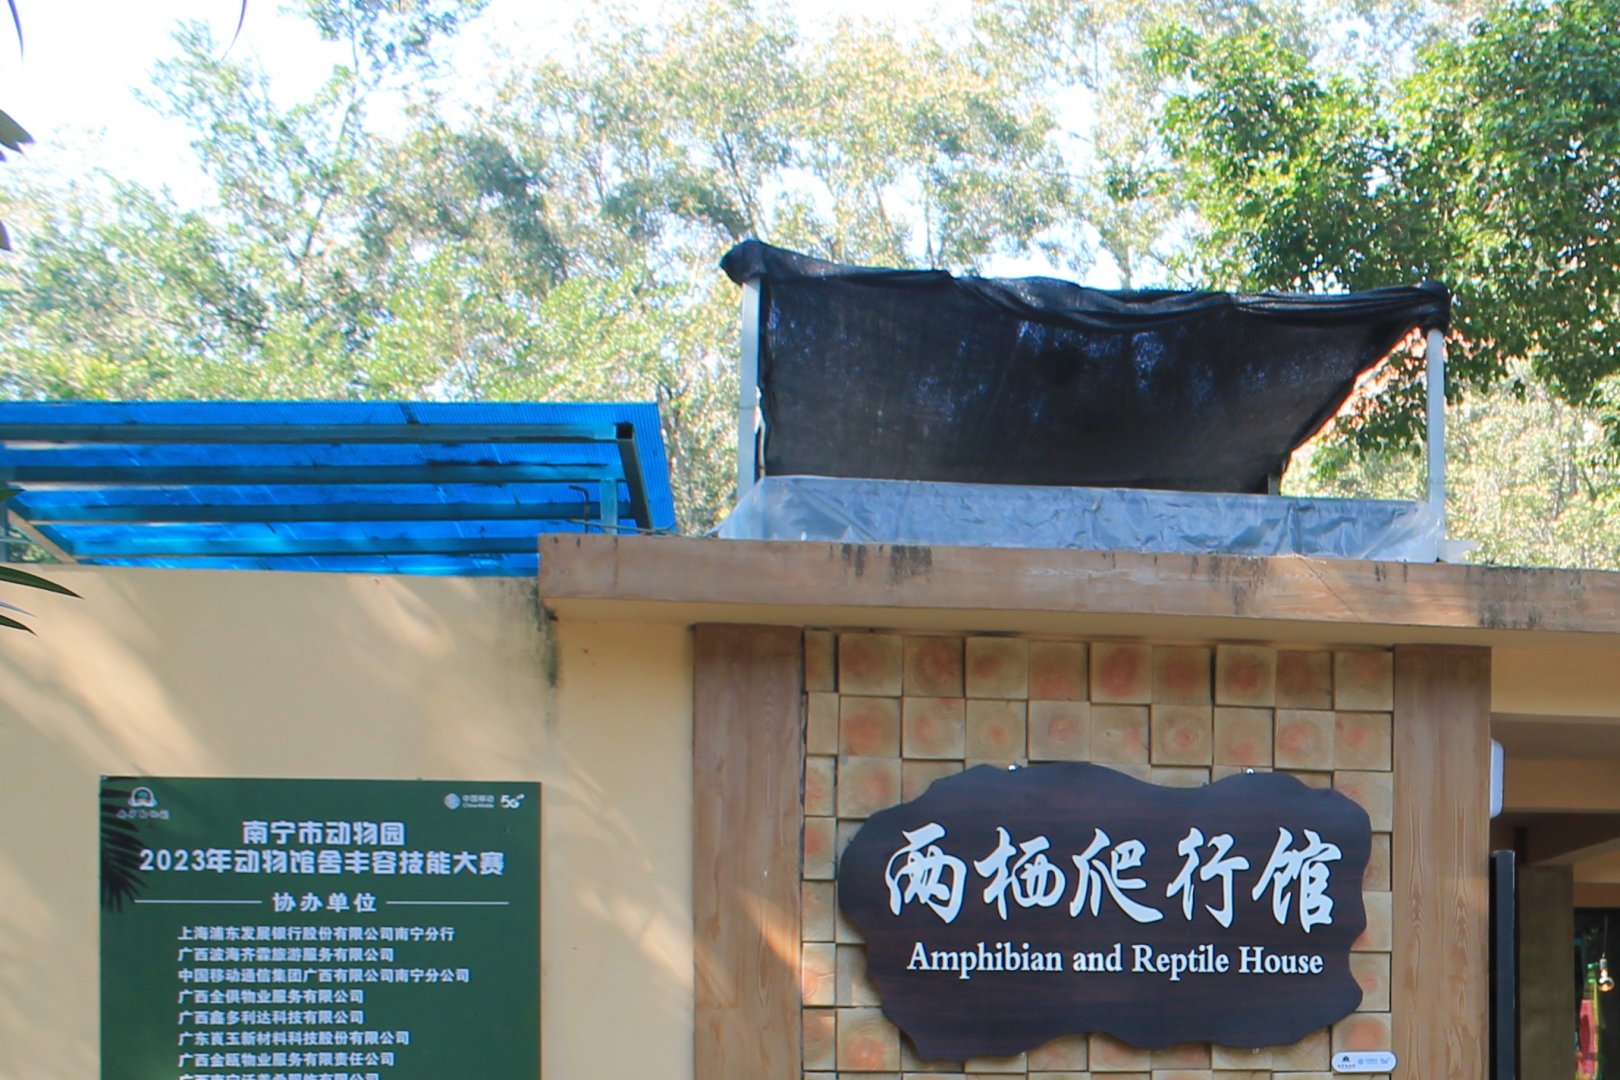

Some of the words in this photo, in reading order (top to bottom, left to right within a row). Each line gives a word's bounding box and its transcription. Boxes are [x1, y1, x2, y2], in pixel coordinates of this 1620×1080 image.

[242, 820, 405, 846] 南宁市动物园
[139, 847, 505, 876] 2023年动物馆舍丰容技能大赛
[884, 822, 1342, 934] 两栖爬行馆
[272, 892, 377, 913] 协办单位
[177, 926, 454, 942] 上海浦东发展银行股份有限公司南宁分行
[907, 942, 1062, 979] Amphibian
[1073, 943, 1122, 971] and
[1132, 944, 1228, 980] Reptile
[1239, 947, 1323, 973] House
[177, 968, 469, 983] 中国移动通信集团广西有限公司南宁分公司
[177, 1010, 364, 1026] 广西鑫多利达科技有限公司
